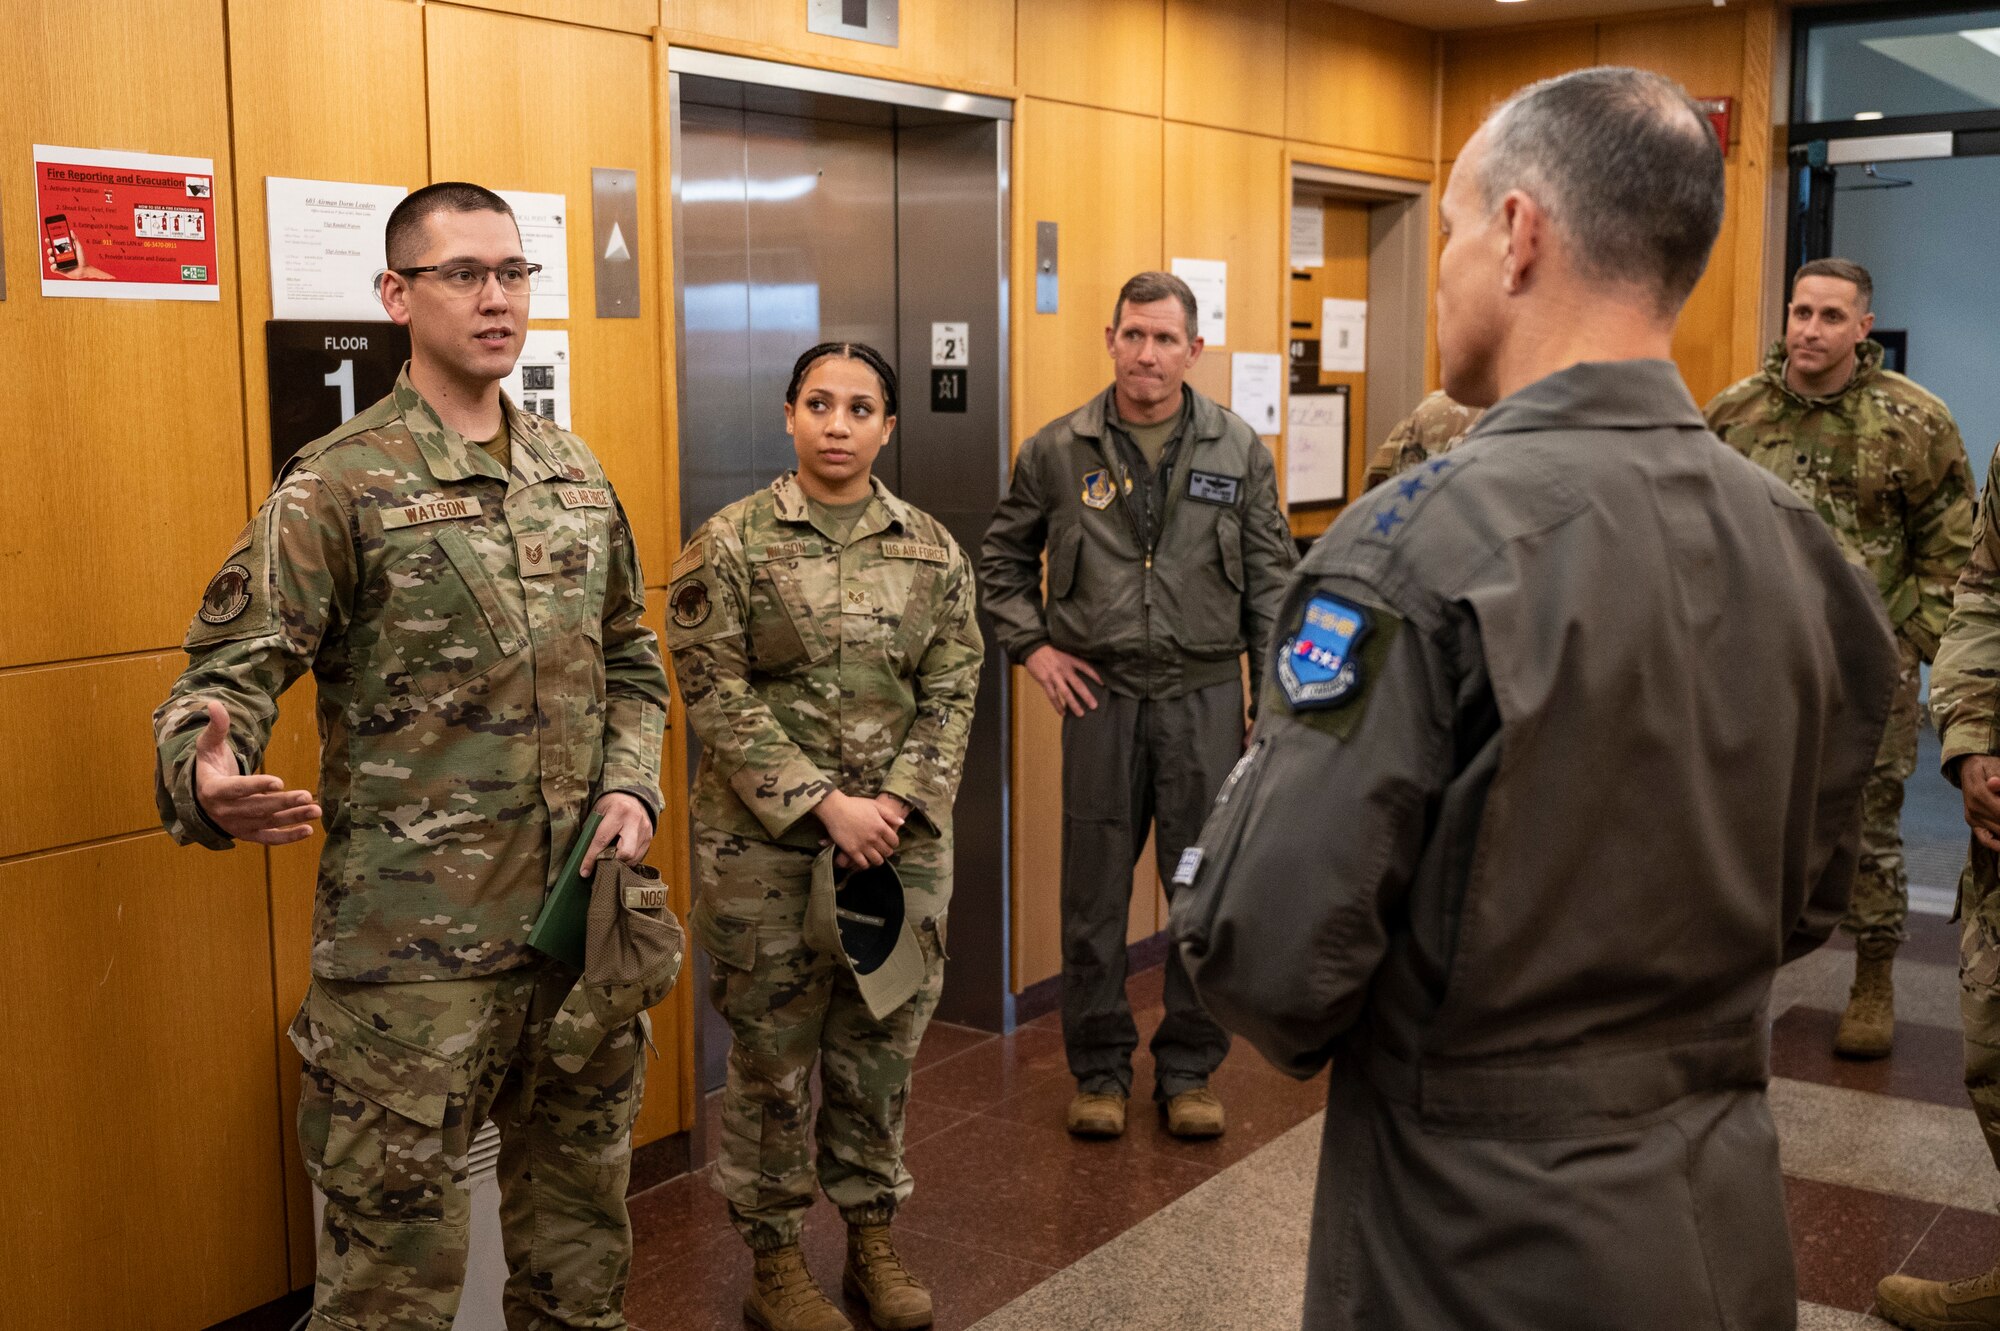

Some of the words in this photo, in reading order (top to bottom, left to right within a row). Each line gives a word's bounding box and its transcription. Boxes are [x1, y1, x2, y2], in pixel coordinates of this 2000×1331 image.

[47, 168, 65, 178] Fire
[68, 170, 114, 184] Reporting
[116, 174, 134, 183] and
[136, 176, 184, 187] Evacuation
[324, 337, 368, 350] FLOOR
[944, 339, 956, 360] 2
[324, 360, 355, 424] 1
[404, 501, 467, 523] WATSON
[765, 543, 806, 559] WILSON
[903, 545, 917, 556] AIR
[919, 547, 946, 560] FORCE
